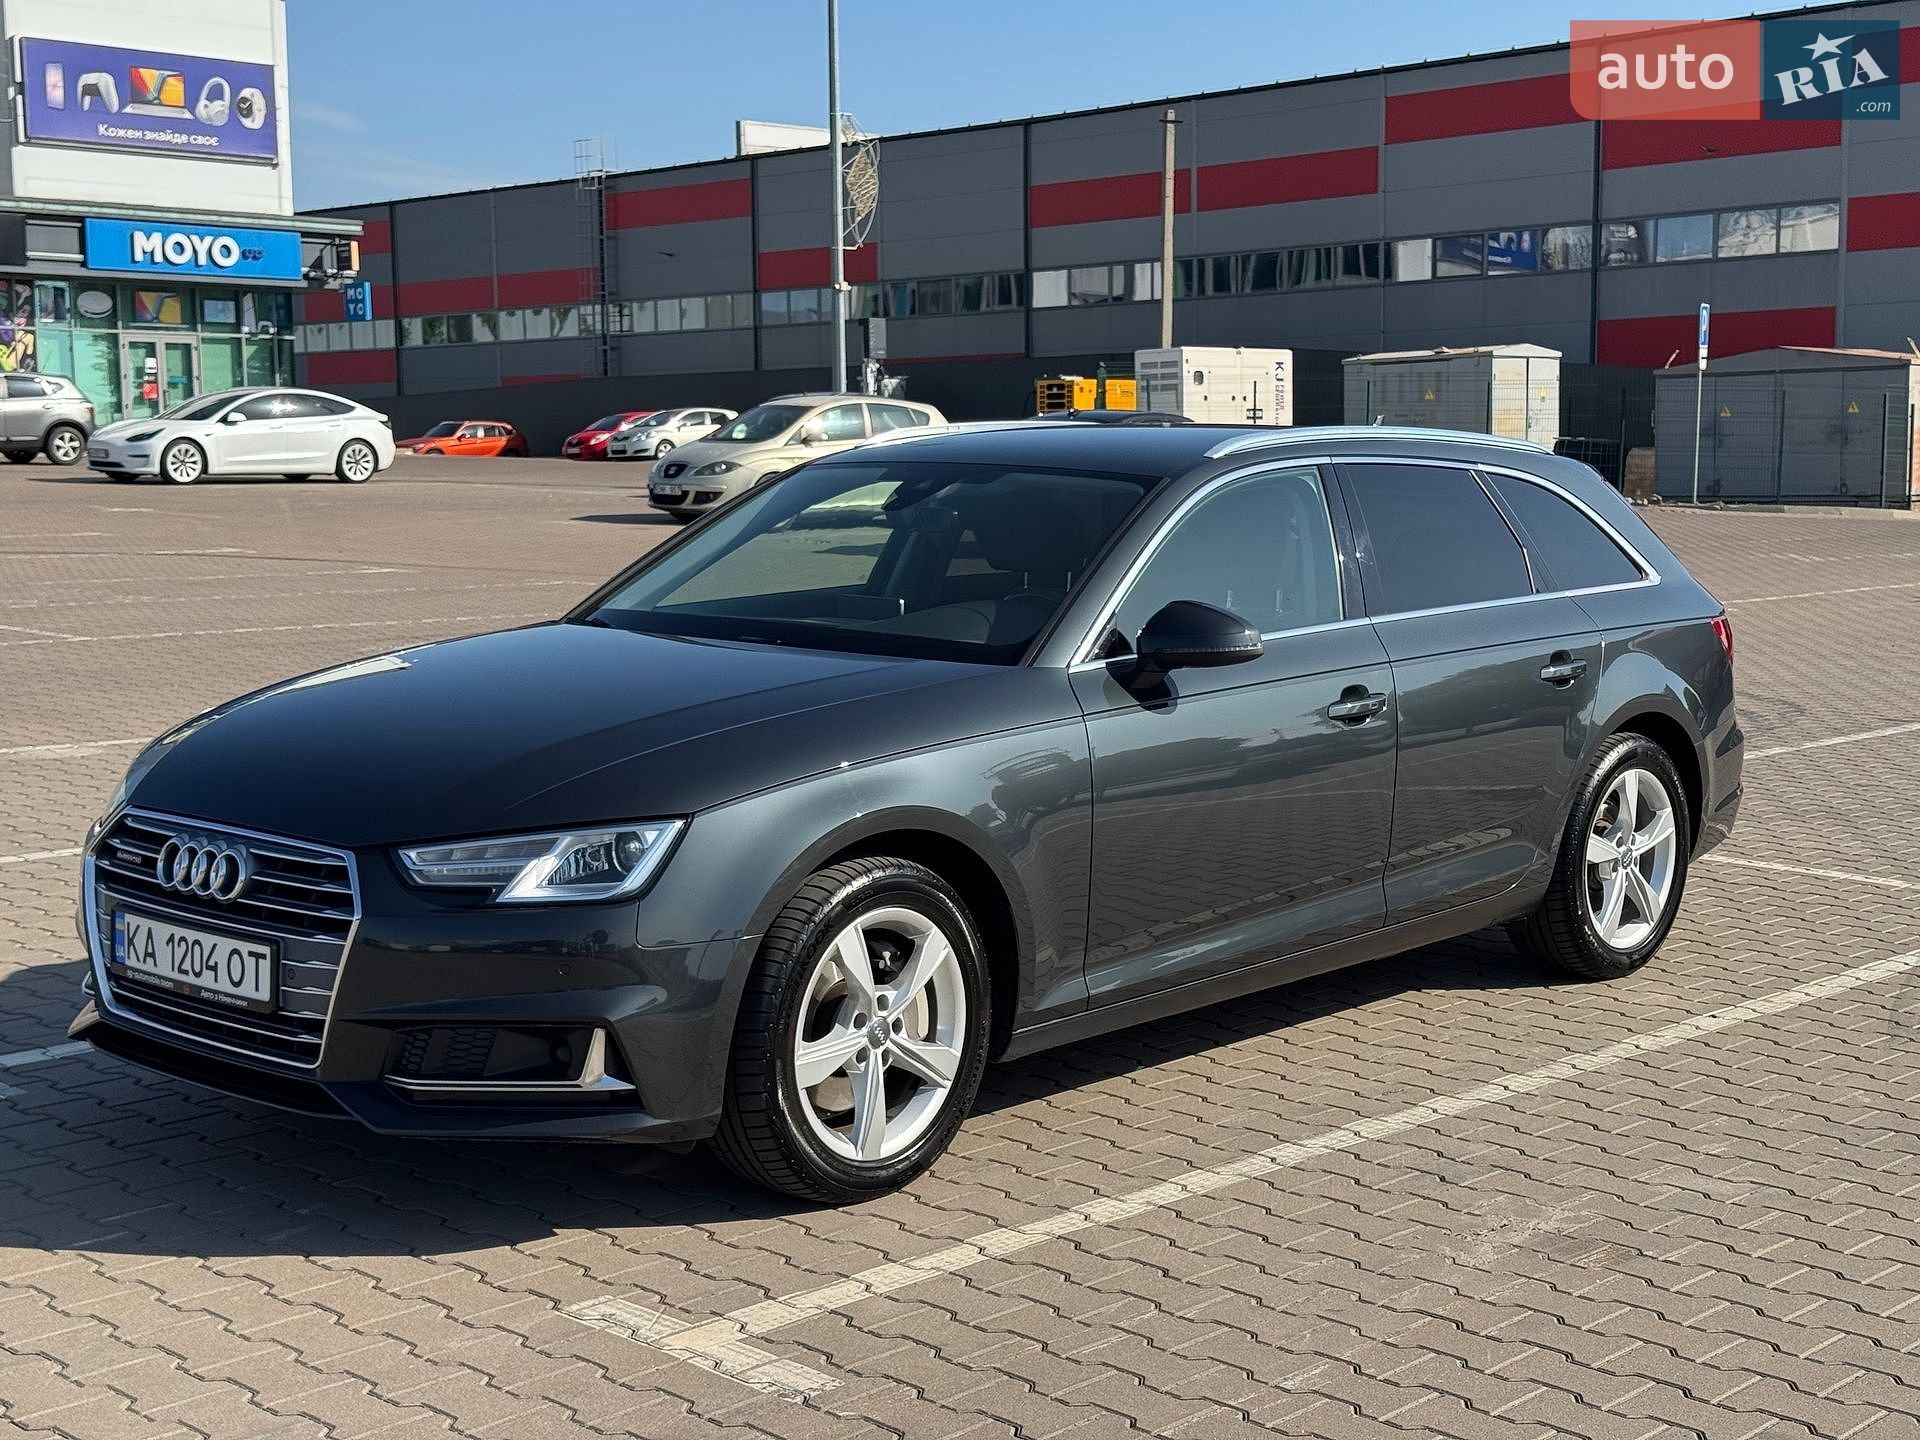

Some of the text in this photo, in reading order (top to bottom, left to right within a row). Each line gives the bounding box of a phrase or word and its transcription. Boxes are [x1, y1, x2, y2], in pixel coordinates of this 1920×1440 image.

[97, 123, 220, 147] Кожен знайде своє
[132, 230, 240, 268] MOYO
[126, 921, 268, 992] KA 1204 OT
